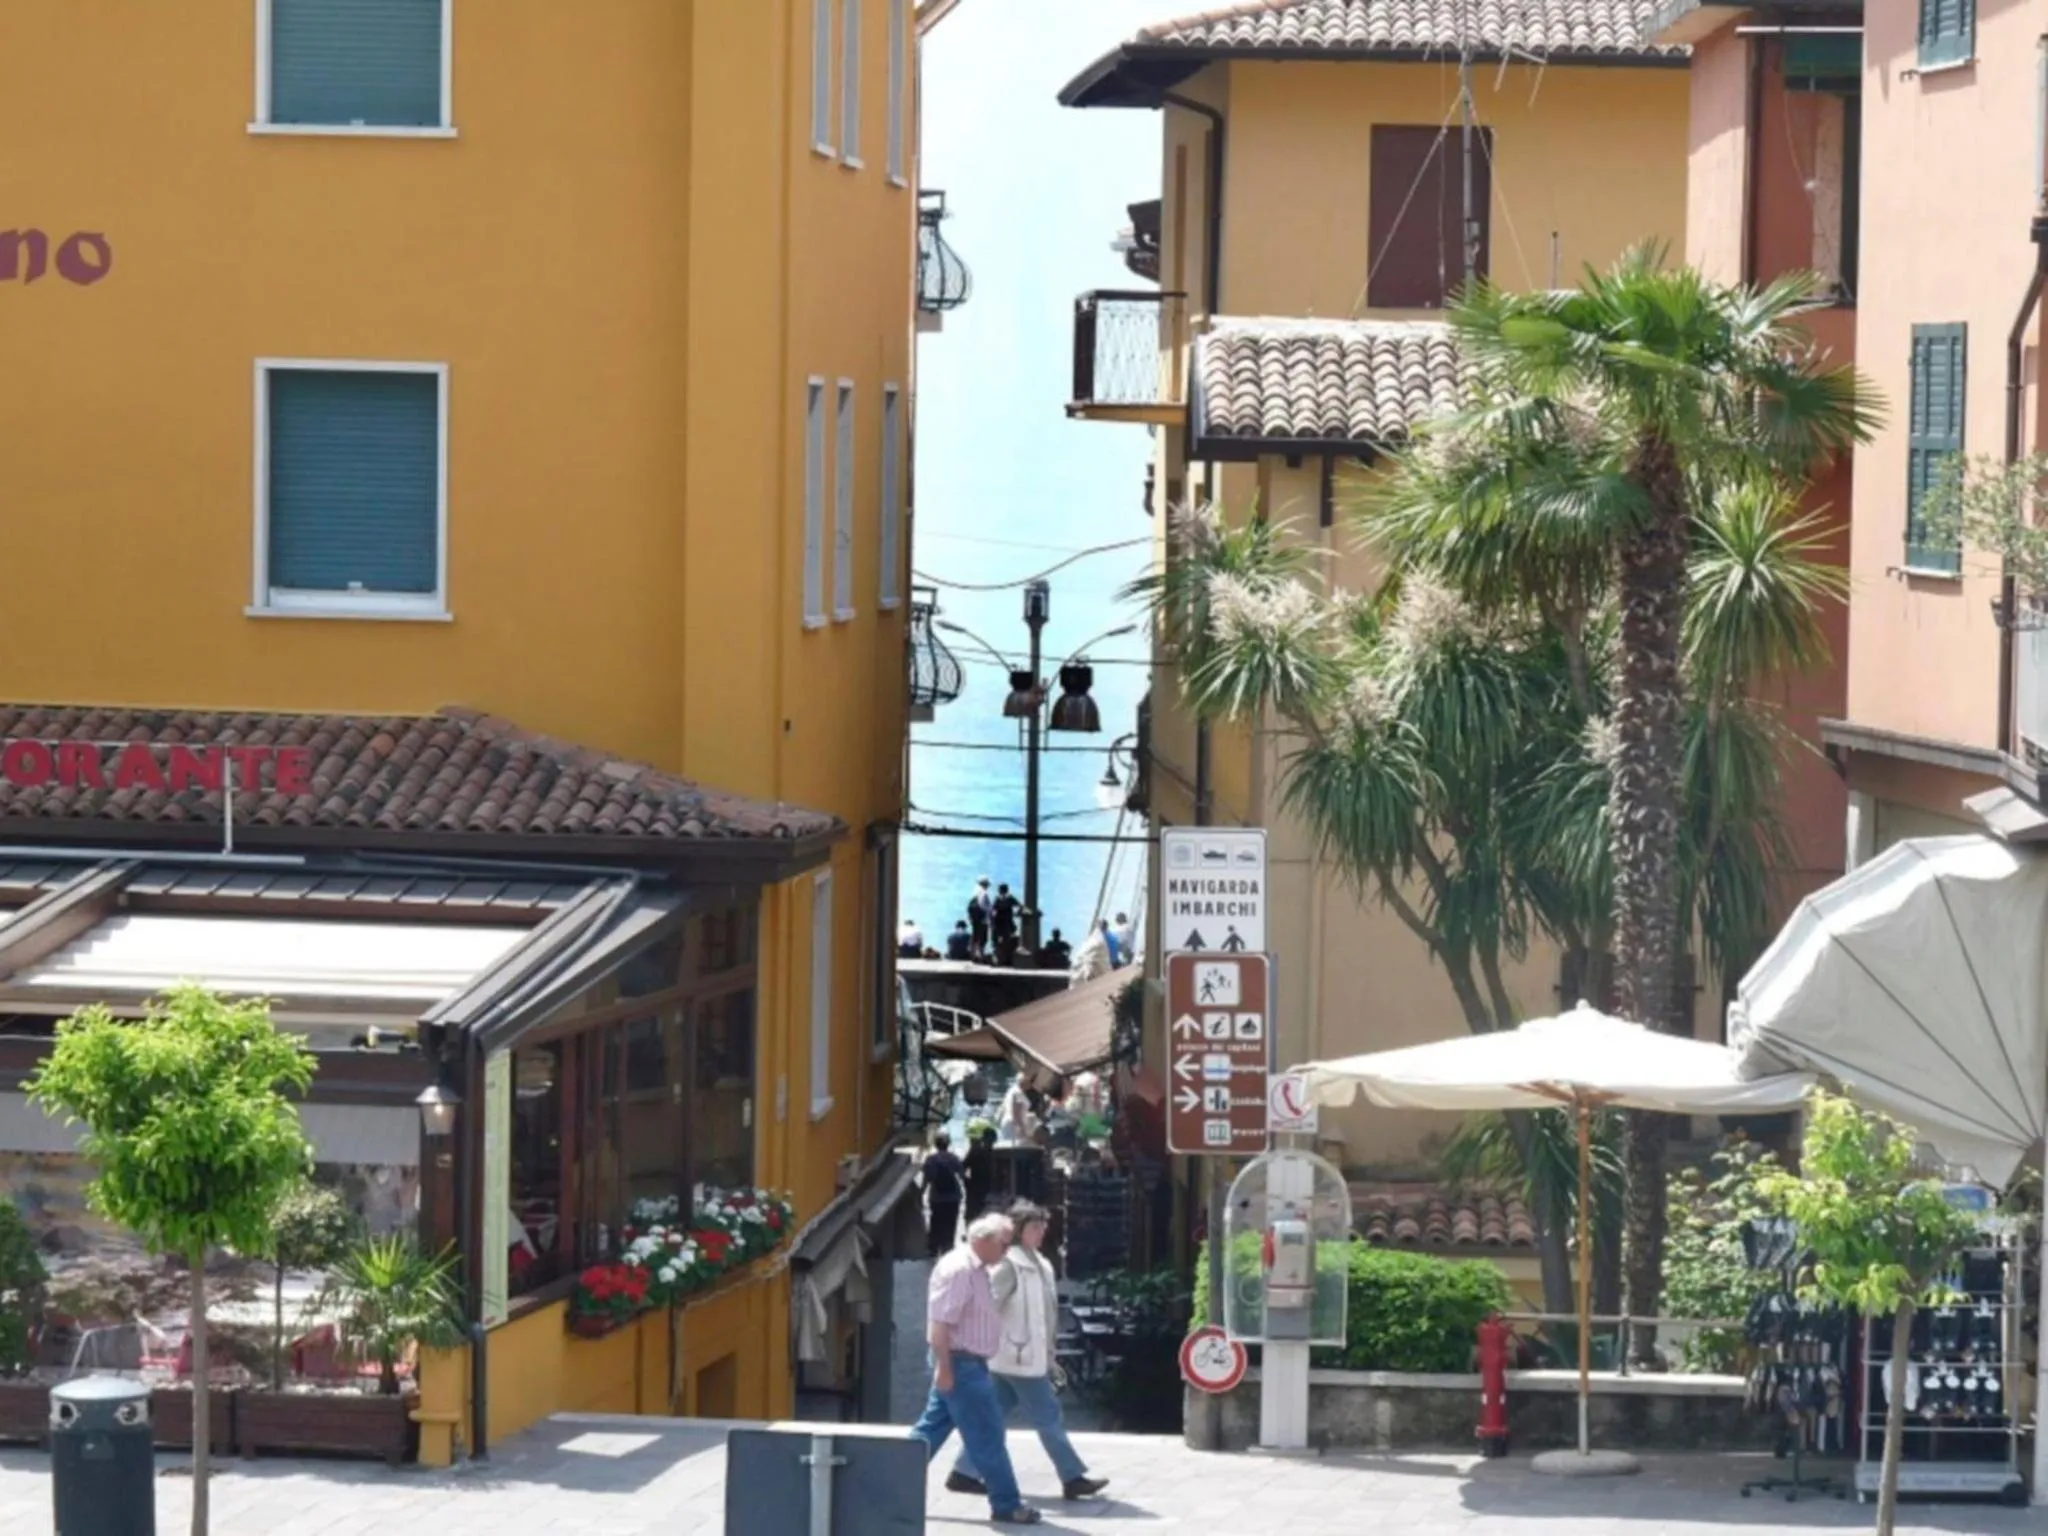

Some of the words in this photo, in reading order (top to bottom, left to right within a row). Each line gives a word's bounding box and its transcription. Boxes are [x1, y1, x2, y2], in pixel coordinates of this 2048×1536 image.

[3, 738, 314, 796] ORANTE
[1168, 878, 1259, 895] NAVIGARDA
[1172, 901, 1257, 917] IMBARCHI
